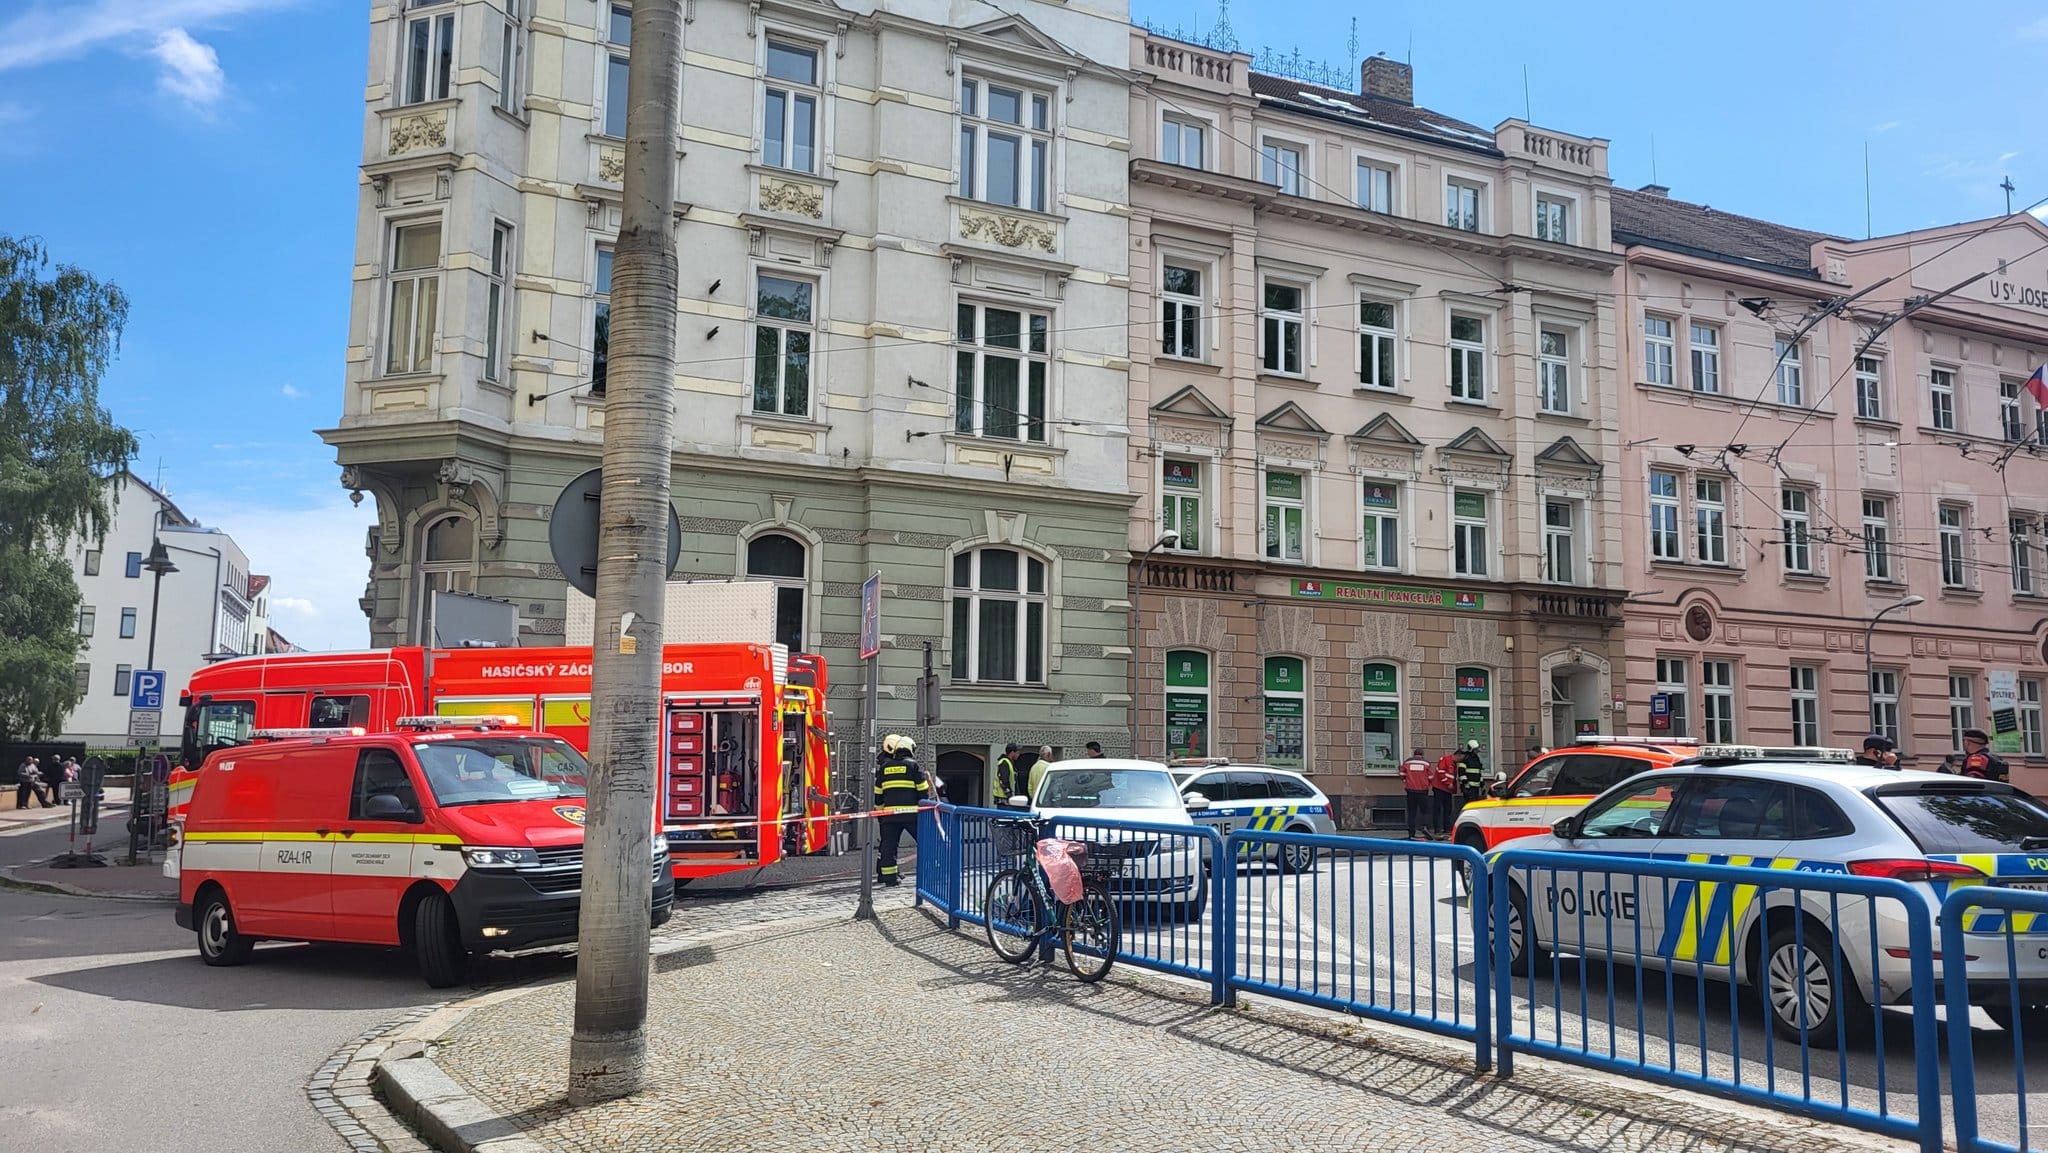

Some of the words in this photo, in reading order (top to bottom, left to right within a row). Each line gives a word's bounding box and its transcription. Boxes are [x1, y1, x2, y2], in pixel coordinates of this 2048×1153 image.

[1990, 280, 1999, 298] U
[1336, 586, 1385, 601] REALITNÍ
[1388, 591, 1442, 605] KANCELÁŘ
[482, 662, 554, 677] HASIČSKÝ
[662, 662, 693, 674] BOR
[277, 850, 312, 864] RZA-L1R
